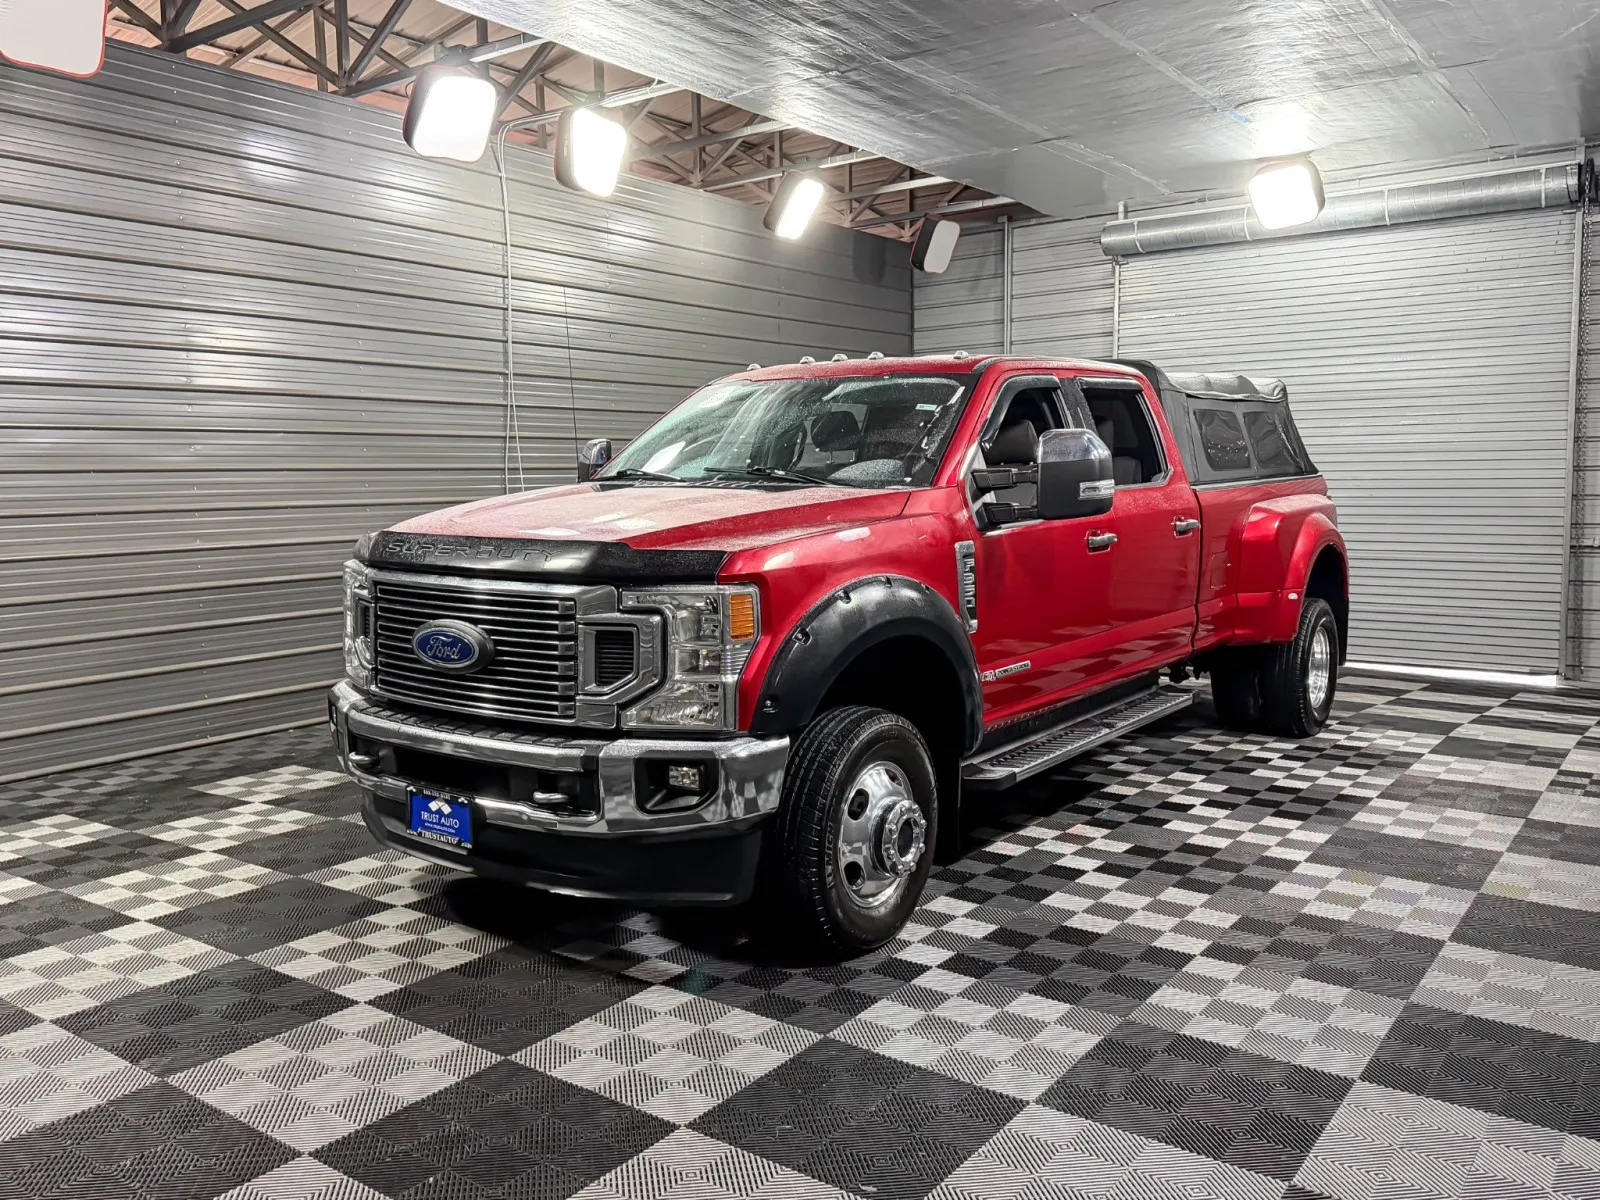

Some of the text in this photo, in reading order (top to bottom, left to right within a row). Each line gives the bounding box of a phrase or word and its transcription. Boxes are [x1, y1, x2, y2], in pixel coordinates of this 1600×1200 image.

[385, 541, 562, 562] SUPER DUTY
[426, 634, 462, 659] Ford
[421, 811, 459, 828] TRUST AUTO
[421, 830, 458, 844] TRUSTAUTO
